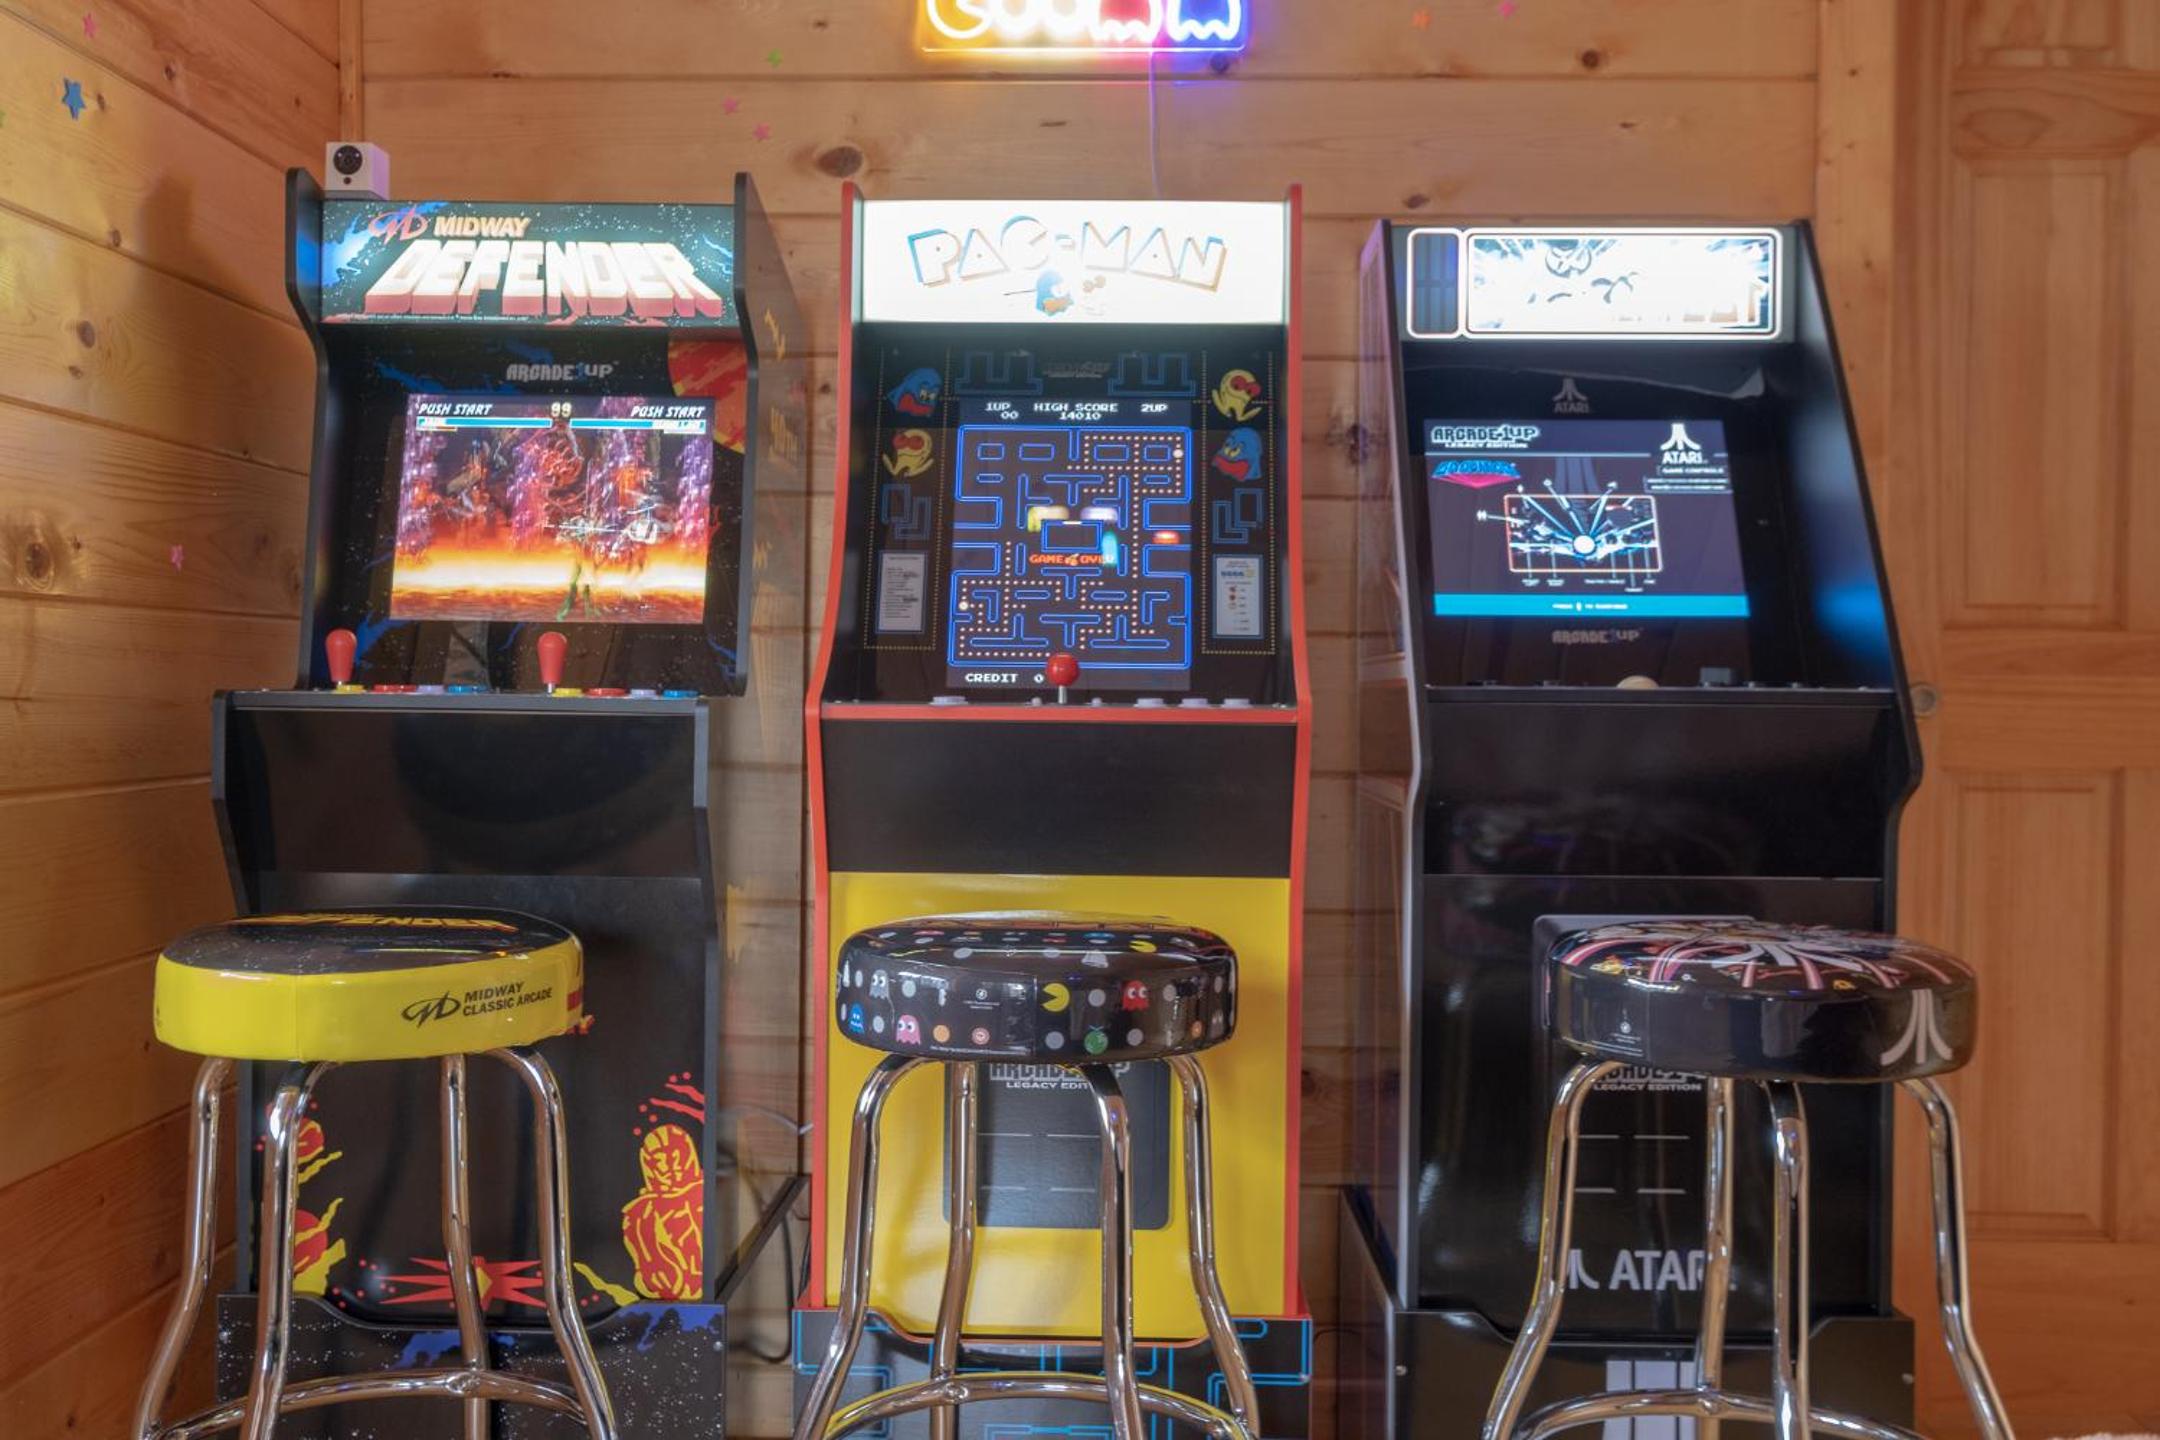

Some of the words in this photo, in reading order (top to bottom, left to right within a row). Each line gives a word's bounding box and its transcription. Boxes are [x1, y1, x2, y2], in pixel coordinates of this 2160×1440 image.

[433, 216, 532, 238] MIDWAY
[907, 214, 1229, 293] PAC-MAN
[365, 239, 723, 317] DEFENDER
[419, 403, 452, 415] PUSH
[454, 403, 493, 415] START
[551, 402, 572, 417] 99
[631, 405, 664, 417] PUSH
[667, 406, 706, 418] START
[985, 402, 1011, 412] 1UP
[1033, 402, 1068, 412] HIGH
[1075, 402, 1119, 413] SCORE
[1140, 403, 1168, 413] 2UP
[1554, 401, 1589, 414] ATARI
[1001, 411, 1019, 420] 00
[1059, 411, 1102, 421] 14010
[1662, 450, 1703, 465] ATARI
[1029, 553, 1065, 564] GAME
[1552, 628, 1641, 644] ARCADEUP
[965, 672, 1018, 684] CREDIT
[1033, 673, 1044, 684] 0
[464, 981, 525, 1003] MIDWAY
[462, 996, 514, 1017] CLASSIC
[516, 987, 553, 1007] ARCADE
[1006, 1082, 1057, 1090] LEGACY
[1060, 1082, 1090, 1090] EDIT
[1593, 1082, 1646, 1091] LEGACY
[1648, 1082, 1702, 1092] EDITION
[1608, 1248, 1706, 1291] ATAR
